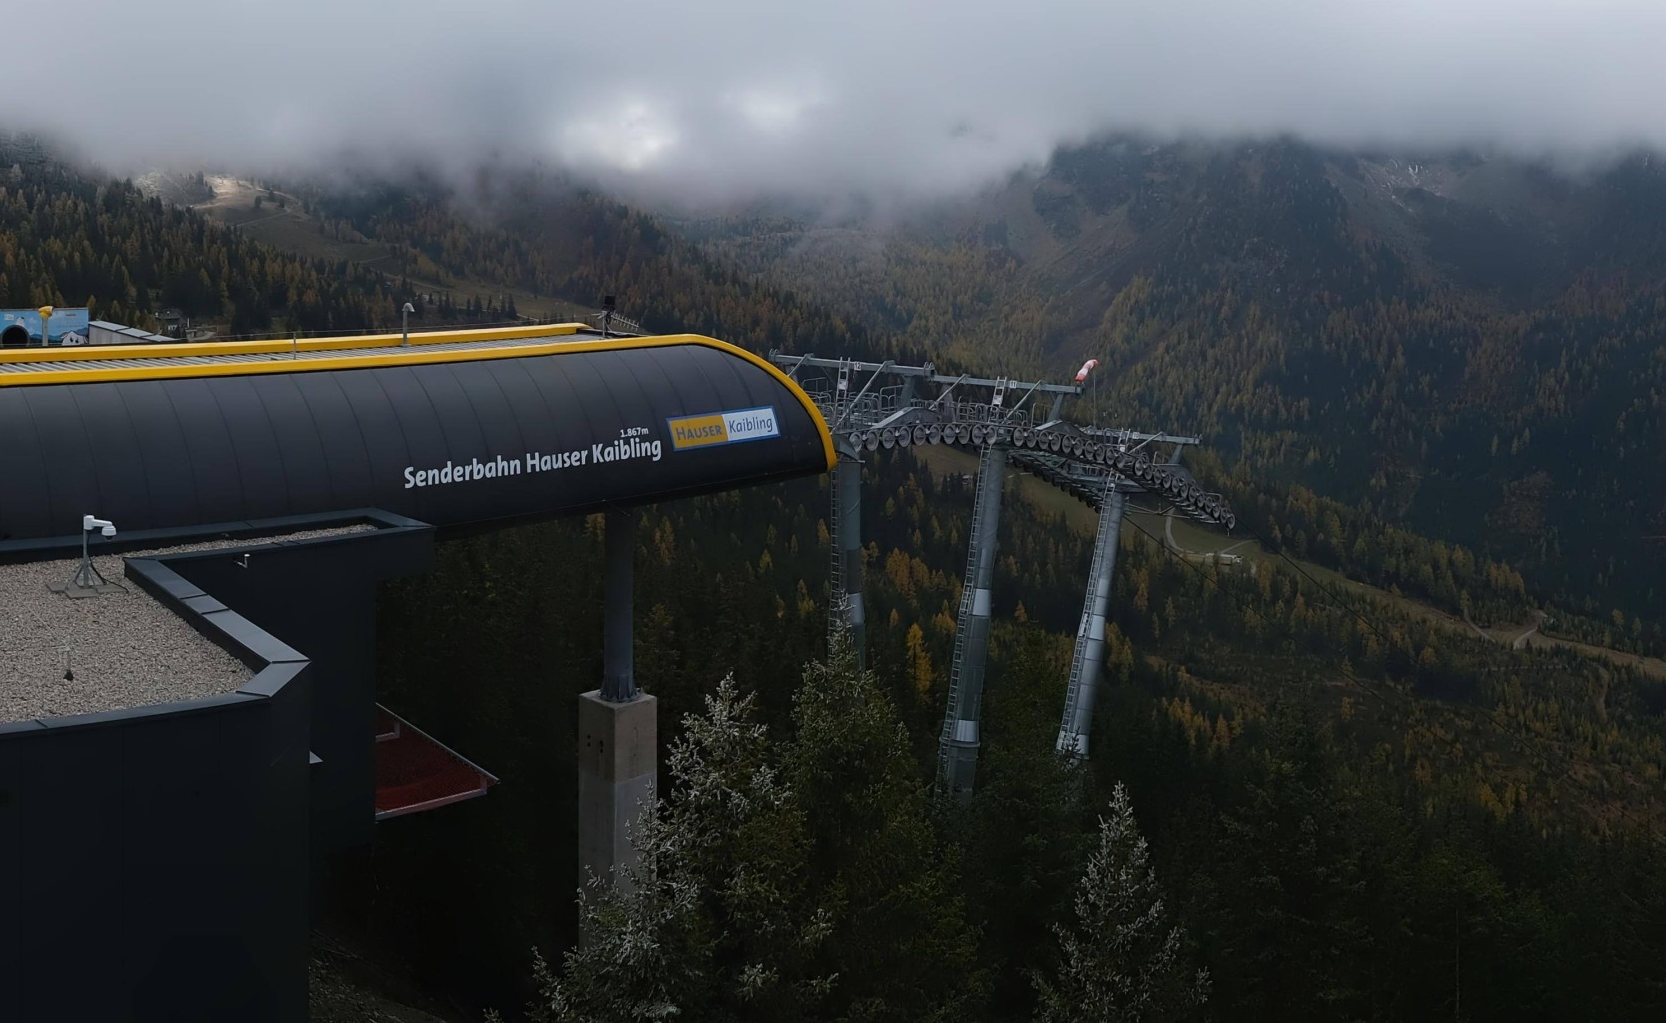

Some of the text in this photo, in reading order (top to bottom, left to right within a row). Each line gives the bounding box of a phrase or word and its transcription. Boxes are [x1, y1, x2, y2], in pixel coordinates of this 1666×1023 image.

[619, 426, 649, 439] 1.867m
[675, 416, 773, 441] HAUSER Kaibling
[404, 437, 663, 489] Senderbahn Hauser Kaibling
